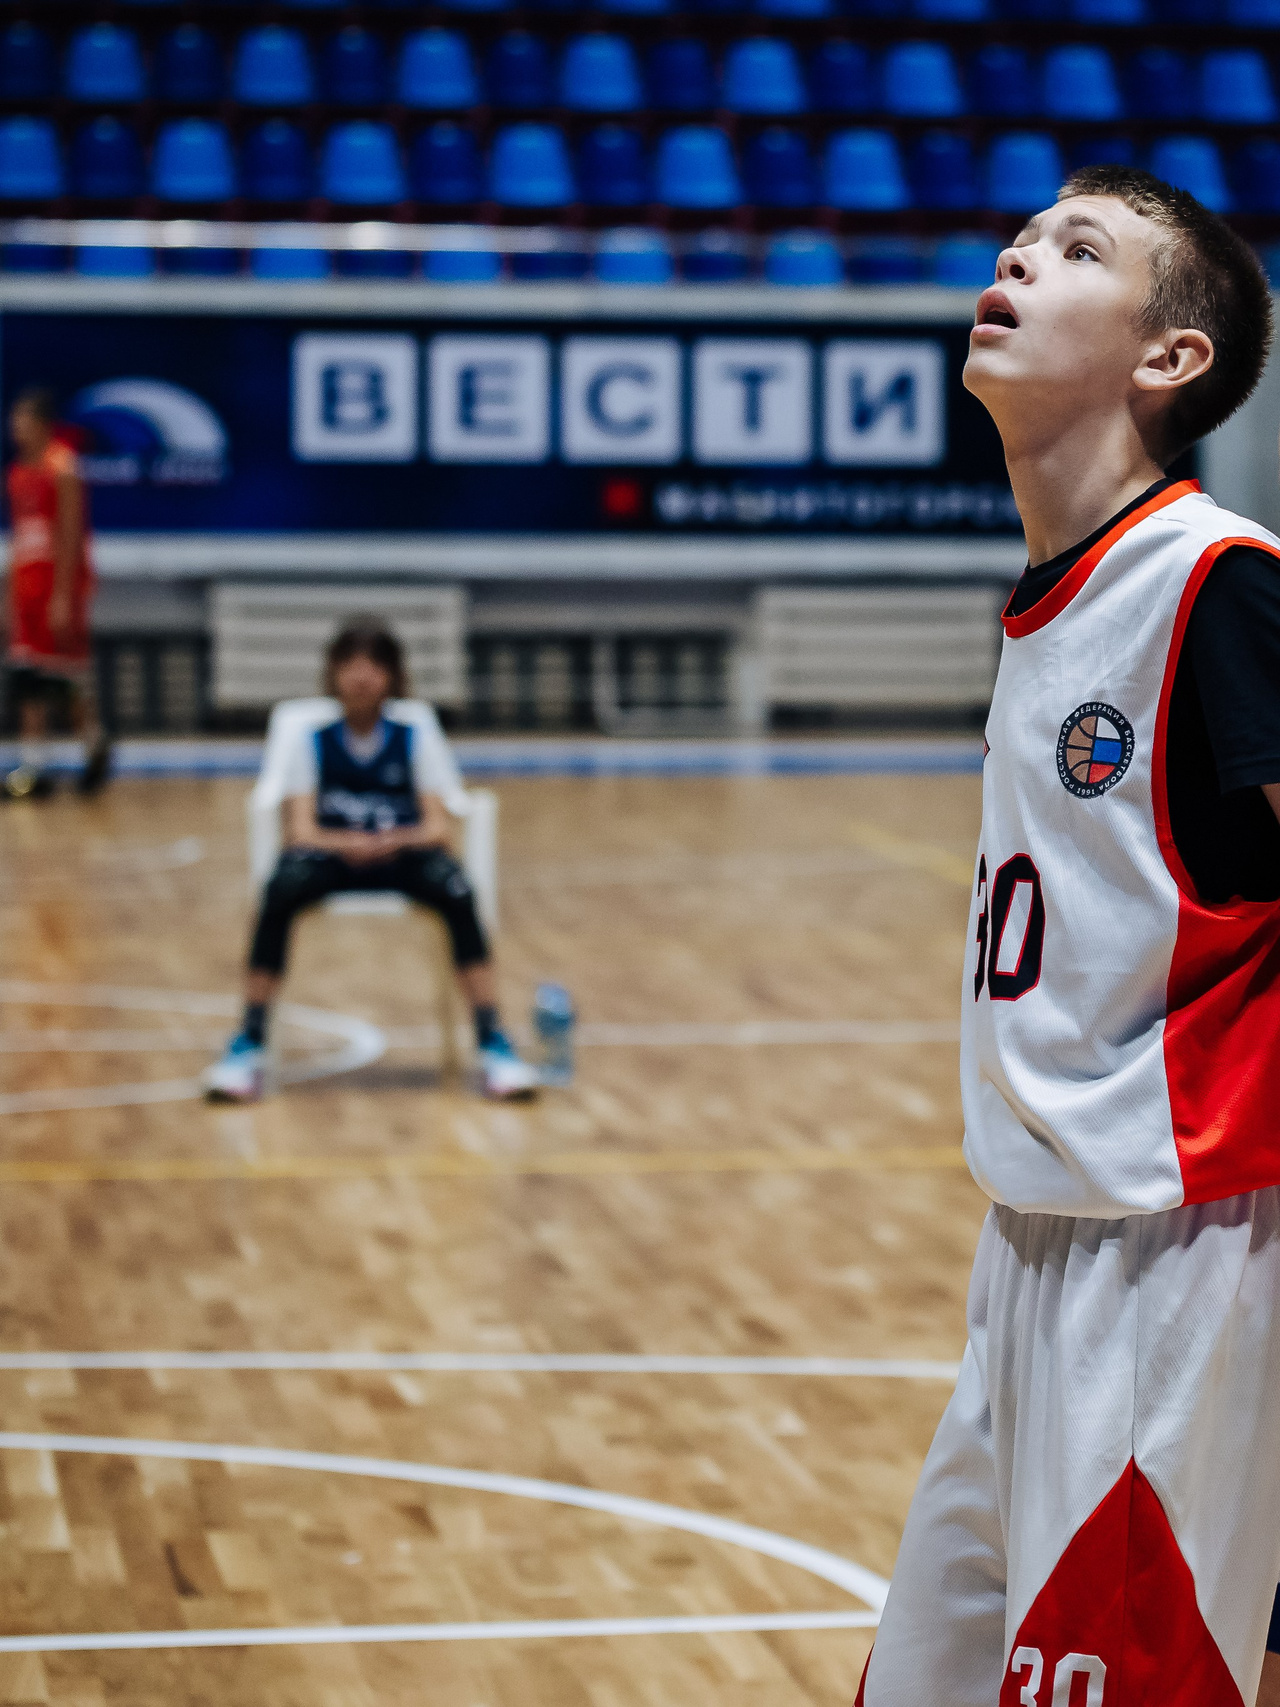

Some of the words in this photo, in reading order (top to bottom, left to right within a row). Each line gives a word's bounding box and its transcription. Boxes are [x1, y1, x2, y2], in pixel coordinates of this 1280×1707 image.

[318, 356, 918, 440] ВЕСТИ
[1074, 704, 1125, 726] ФЕДЕРАЦИЯ
[1098, 729, 1133, 791] БАСКЕТБОЛА
[974, 852, 1047, 1003] 30
[1011, 1645, 1107, 1707] 30
